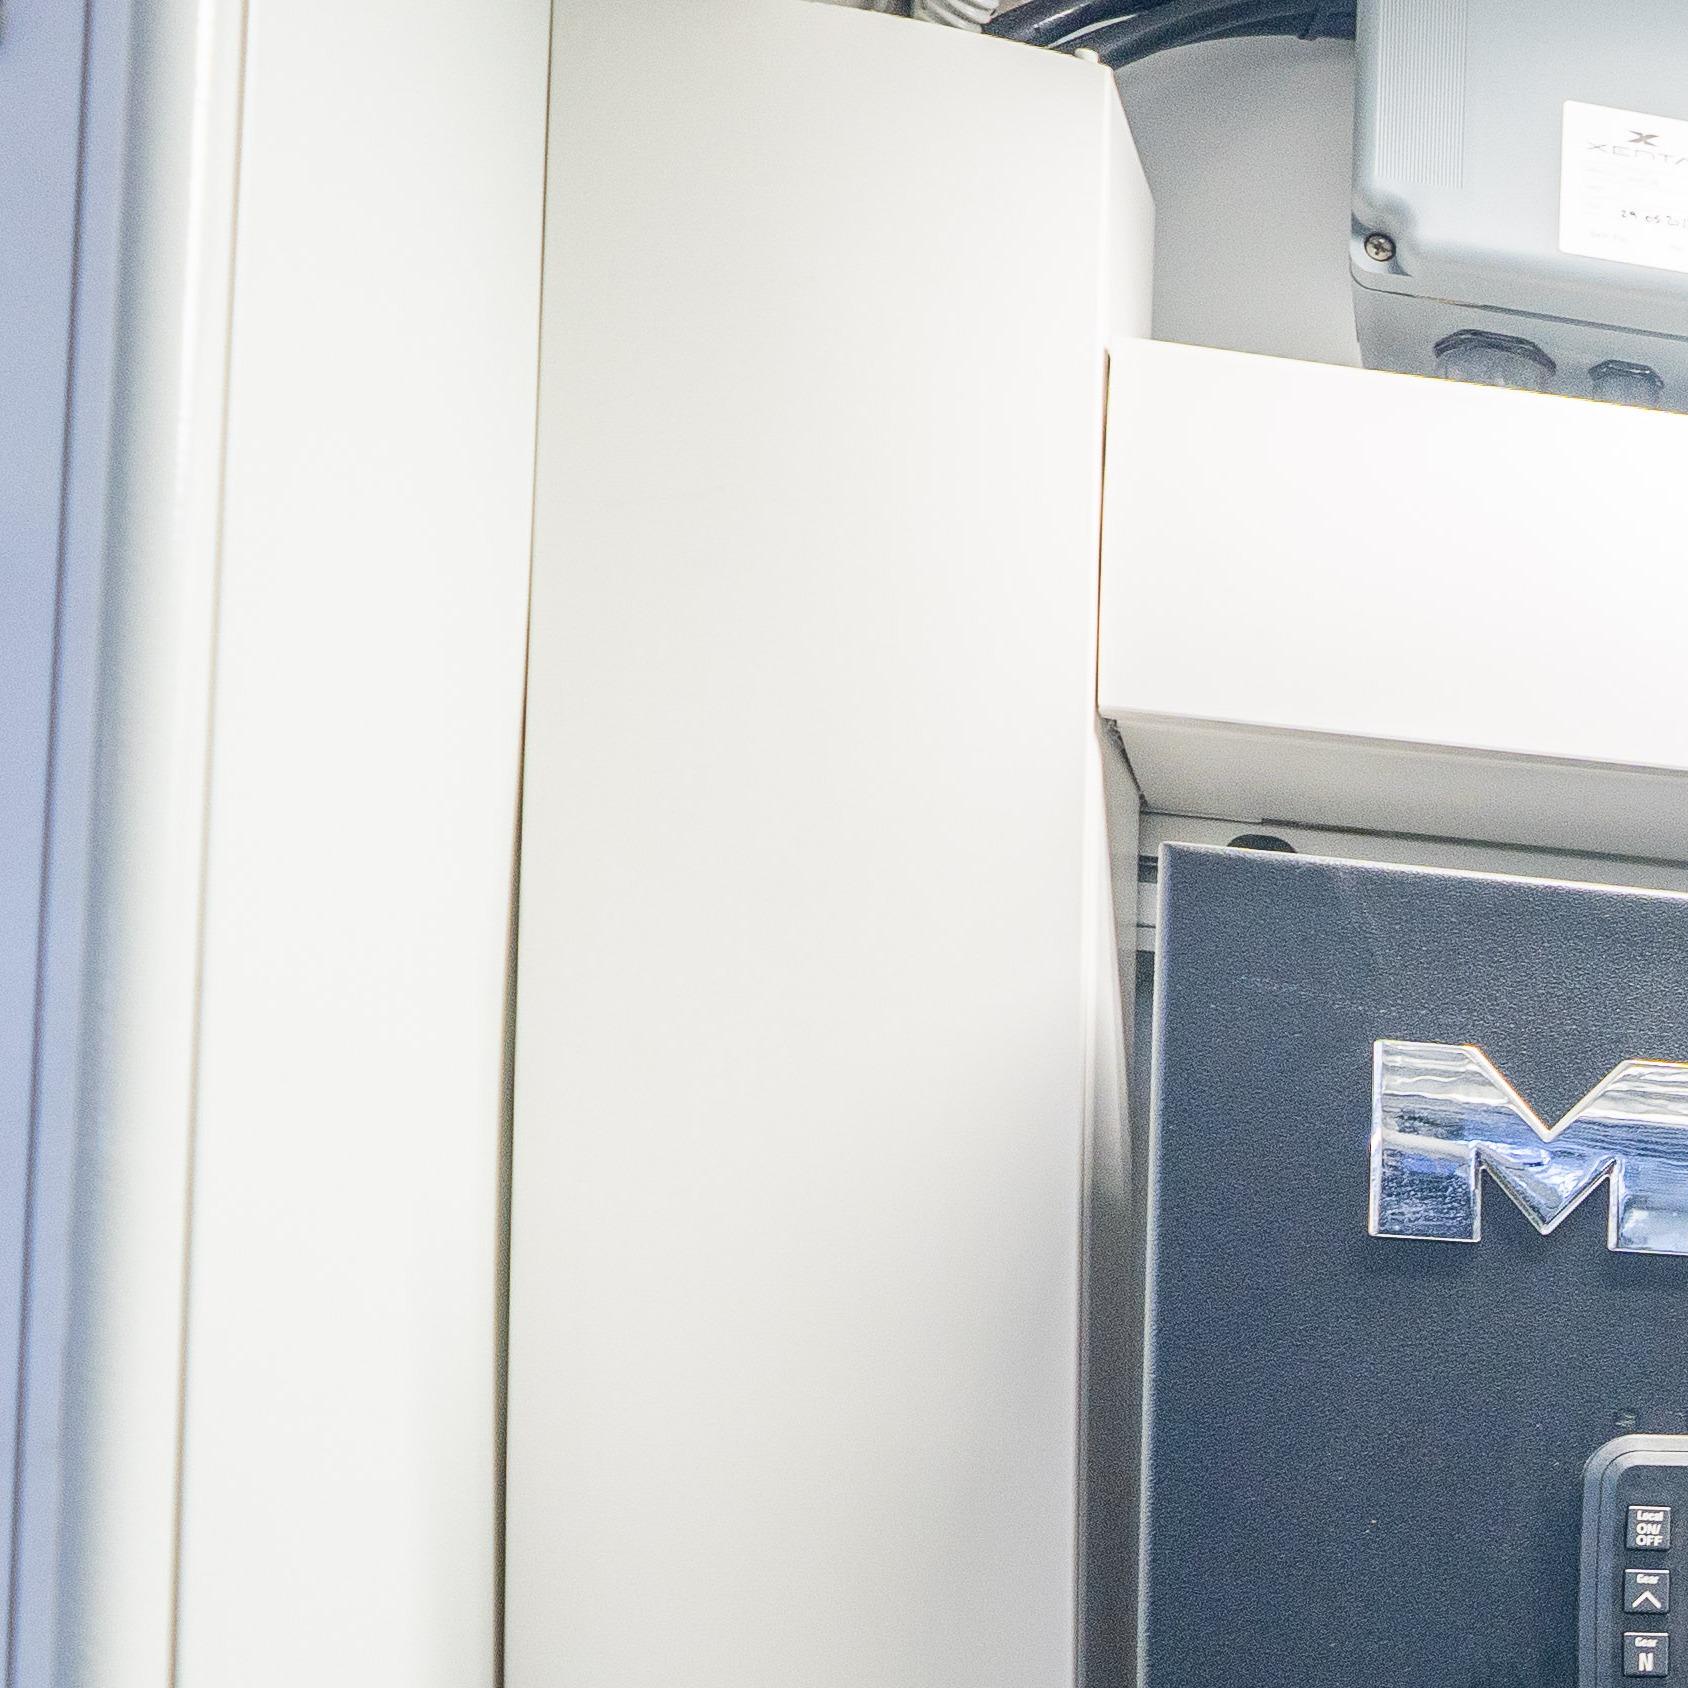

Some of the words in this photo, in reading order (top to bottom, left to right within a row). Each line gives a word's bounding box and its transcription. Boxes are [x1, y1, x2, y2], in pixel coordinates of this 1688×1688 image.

[1636, 1510, 1664, 1522] Local
[1635, 1535, 1664, 1546] OFF
[1638, 1652, 1654, 1672] N
